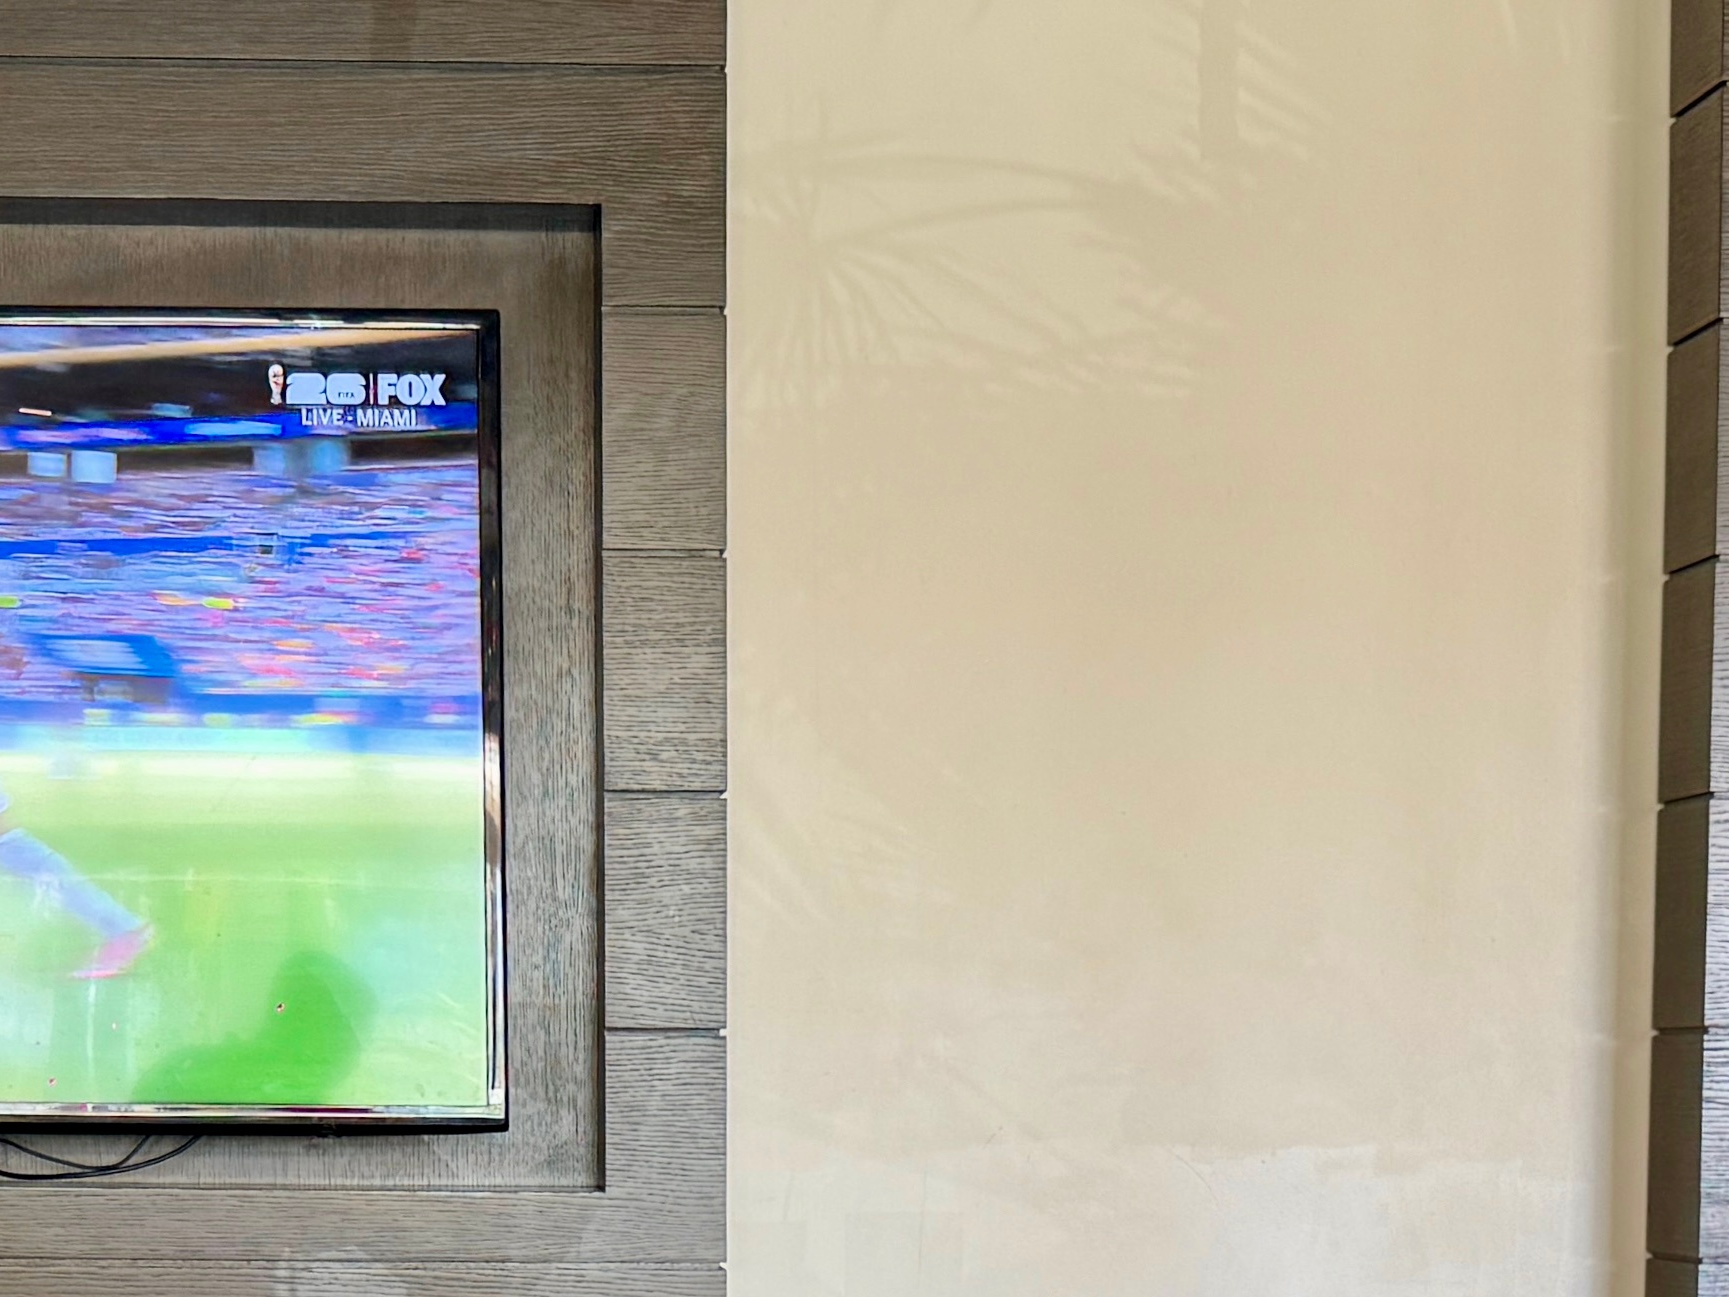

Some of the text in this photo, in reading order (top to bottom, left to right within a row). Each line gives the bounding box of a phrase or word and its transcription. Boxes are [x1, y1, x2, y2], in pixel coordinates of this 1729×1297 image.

[286, 372, 446, 406] 26 FOX
[301, 408, 417, 427] LIVE MIAMI
